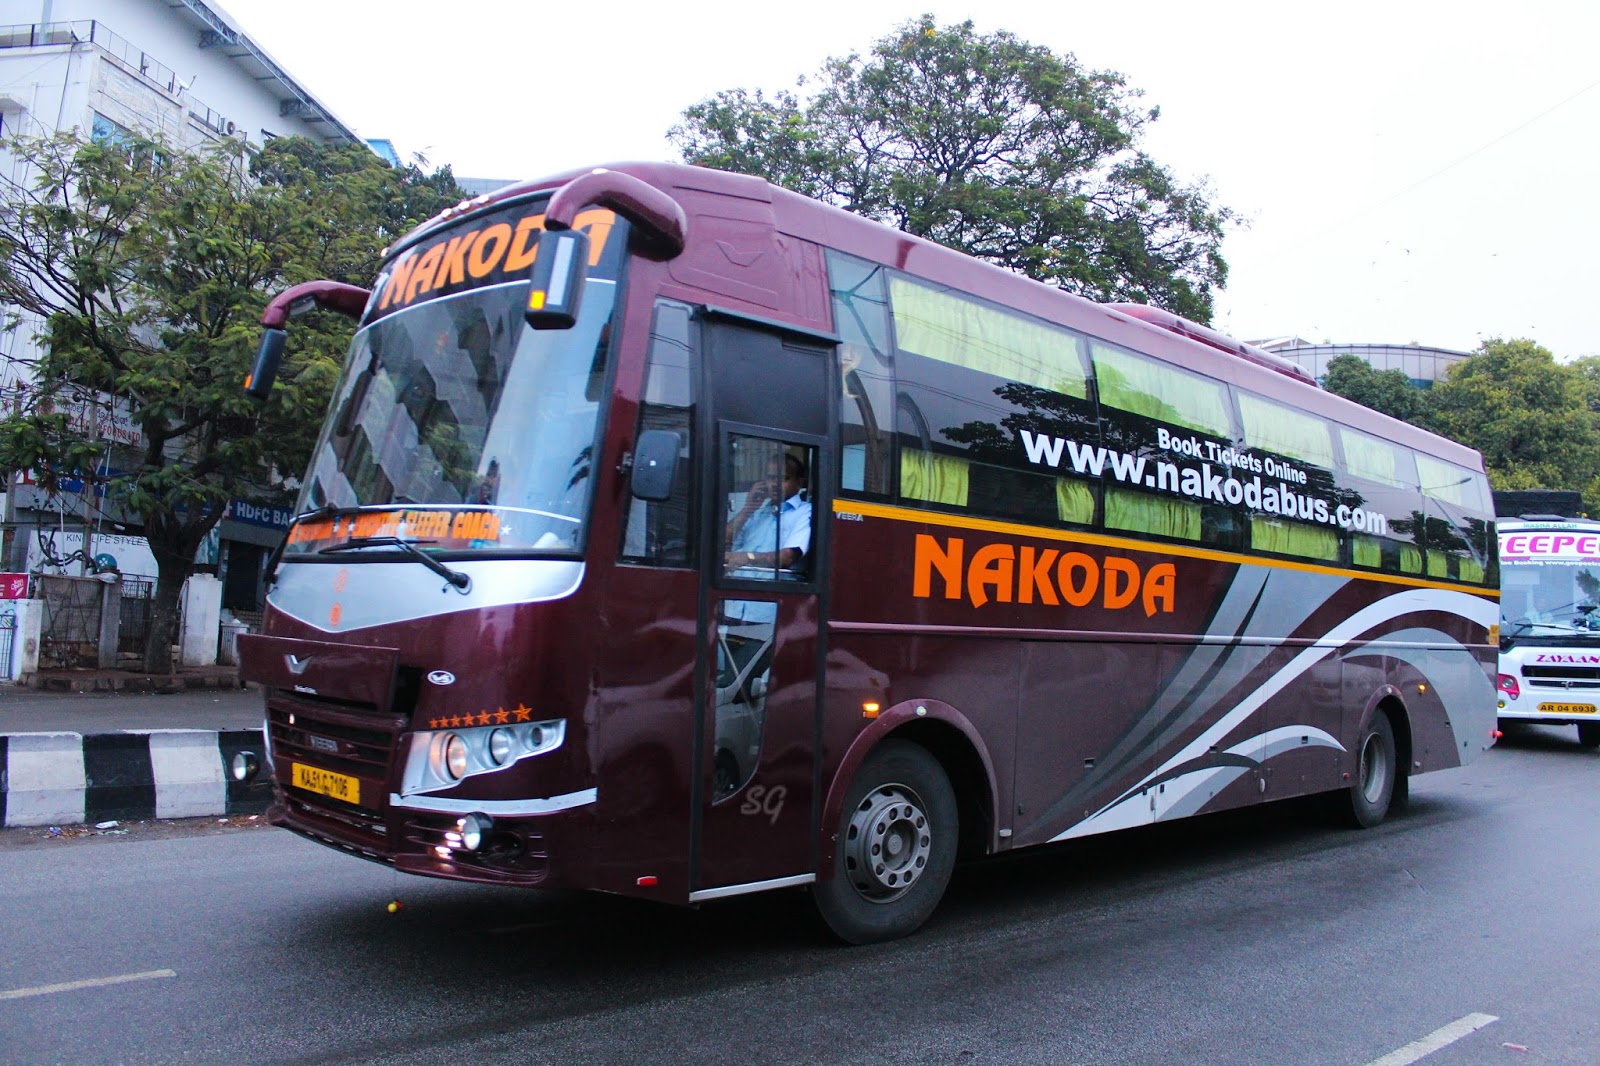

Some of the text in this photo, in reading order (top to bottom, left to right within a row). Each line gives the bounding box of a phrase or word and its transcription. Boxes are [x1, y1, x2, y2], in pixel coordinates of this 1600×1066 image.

[380, 209, 616, 310] NAKODA
[1157, 427, 1308, 485] Book Tickets Online
[1020, 429, 1387, 535] www.nakodabus.com
[237, 502, 294, 527] HDFC BA
[405, 510, 451, 538] SLEEPER
[451, 511, 500, 540] COACH
[836, 511, 864, 522] VEERA
[66, 533, 83, 543] KIN
[91, 536, 113, 544] LFE
[1498, 536, 1600, 554] EEPE
[913, 533, 1176, 618] NAKODA
